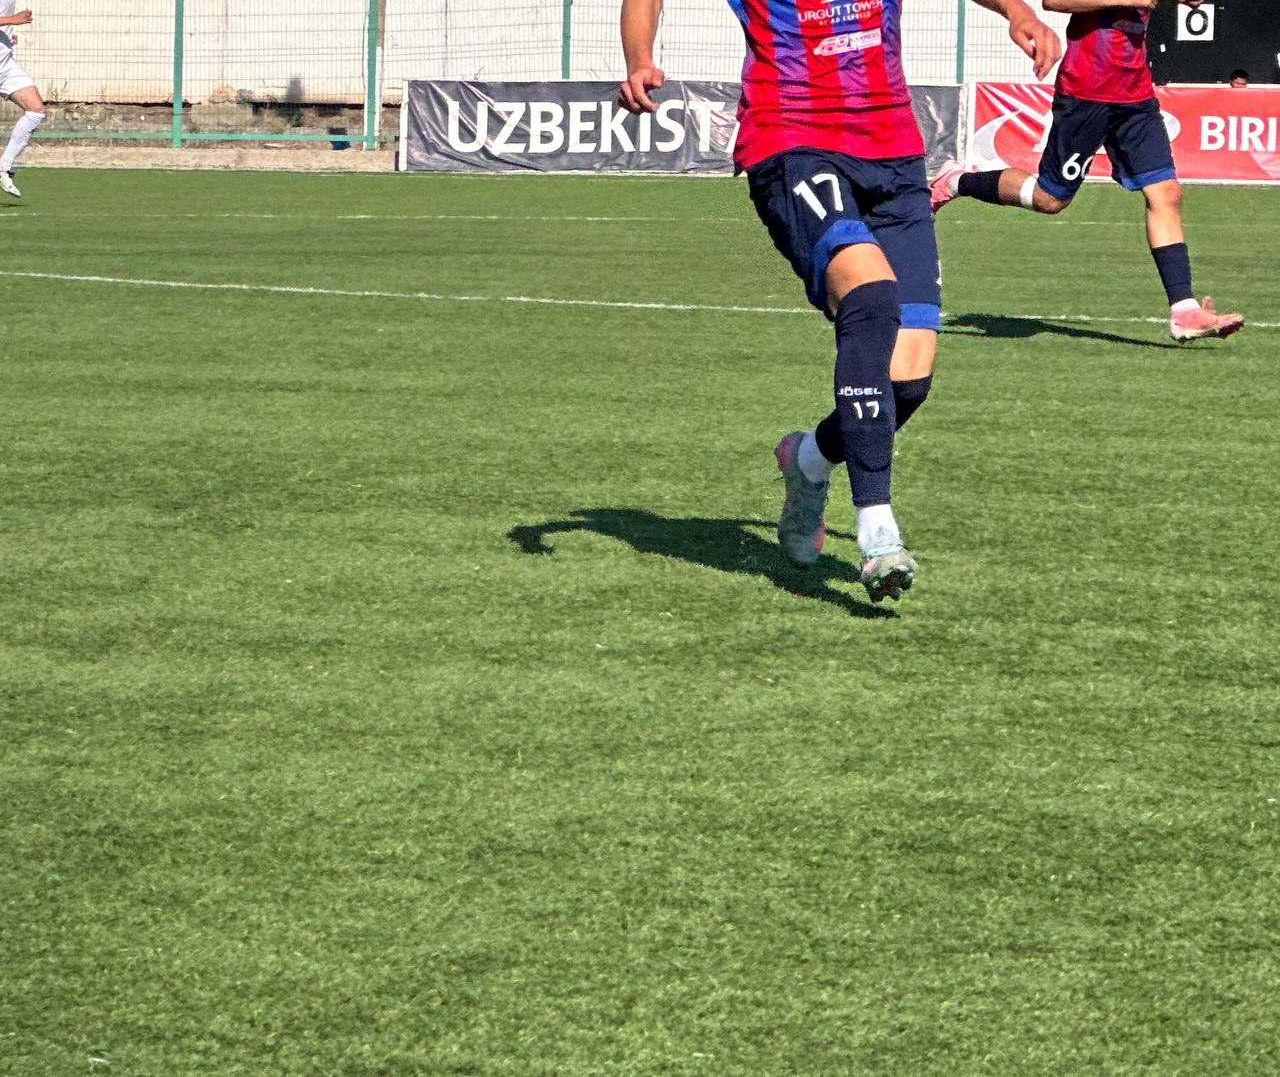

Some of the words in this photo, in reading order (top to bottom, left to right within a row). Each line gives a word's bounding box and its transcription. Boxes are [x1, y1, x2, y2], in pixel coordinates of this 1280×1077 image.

[798, 5, 841, 22] URGUT
[447, 100, 741, 157] UZBEKIST
[1199, 115, 1277, 152] BIRI
[793, 173, 844, 221] 17
[837, 386, 882, 396] JÖGEL
[853, 401, 879, 419] 17
